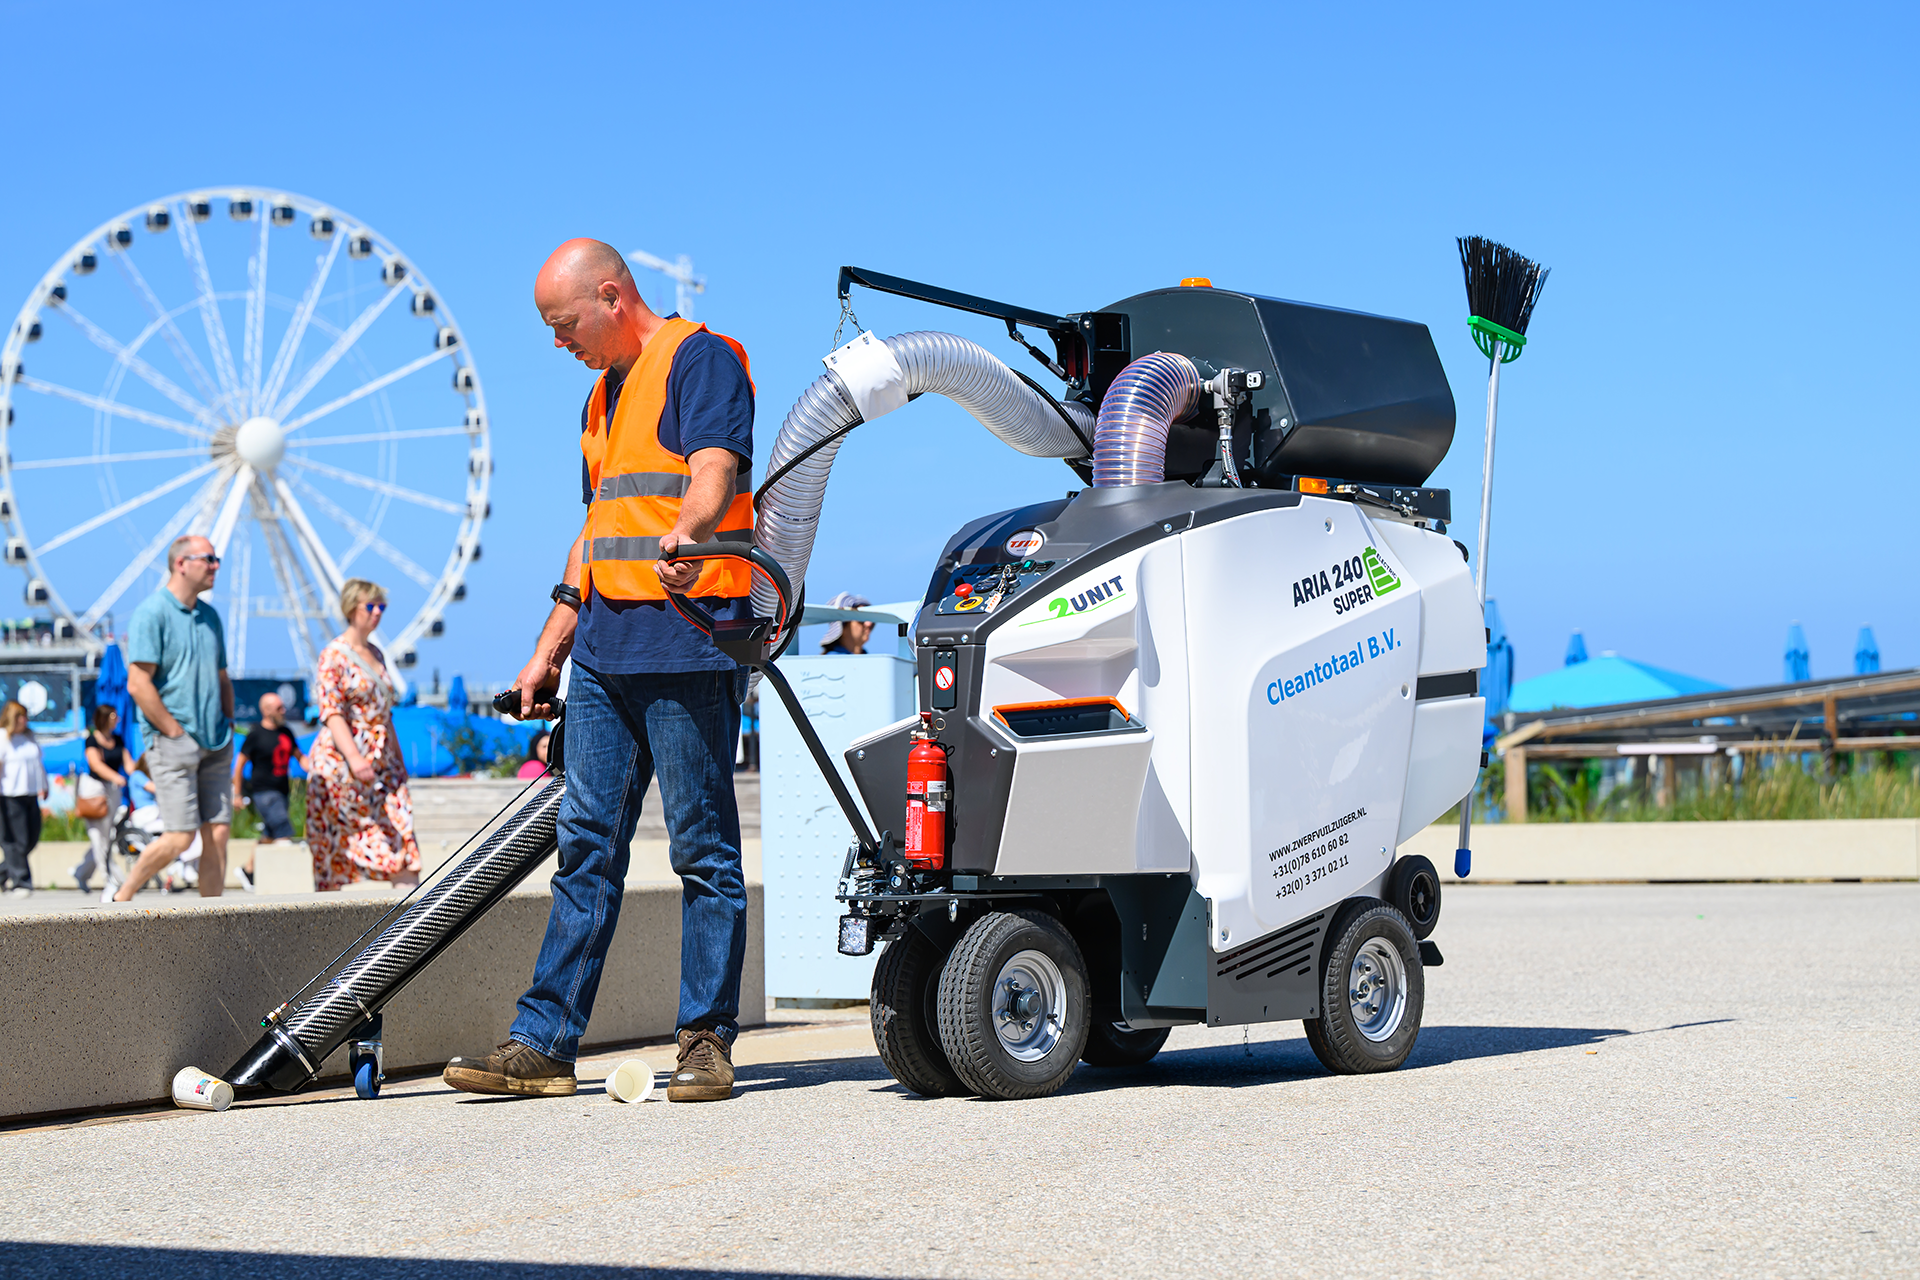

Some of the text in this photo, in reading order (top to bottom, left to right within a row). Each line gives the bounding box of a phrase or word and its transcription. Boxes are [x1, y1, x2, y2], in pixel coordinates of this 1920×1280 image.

[1292, 555, 1363, 608] ARIA 240
[1376, 553, 1398, 580] ELECTRIC
[1048, 574, 1124, 618] 2UNIT
[1333, 584, 1374, 615] SUPER
[1266, 627, 1402, 706] Cleantotaal B.V.
[1268, 807, 1367, 862] WWW.ZWERFVUILZUIGER.NL
[1272, 832, 1349, 879] +31(0)78 610 60 82
[1275, 854, 1349, 899] +32(0) 3 371 02 11
